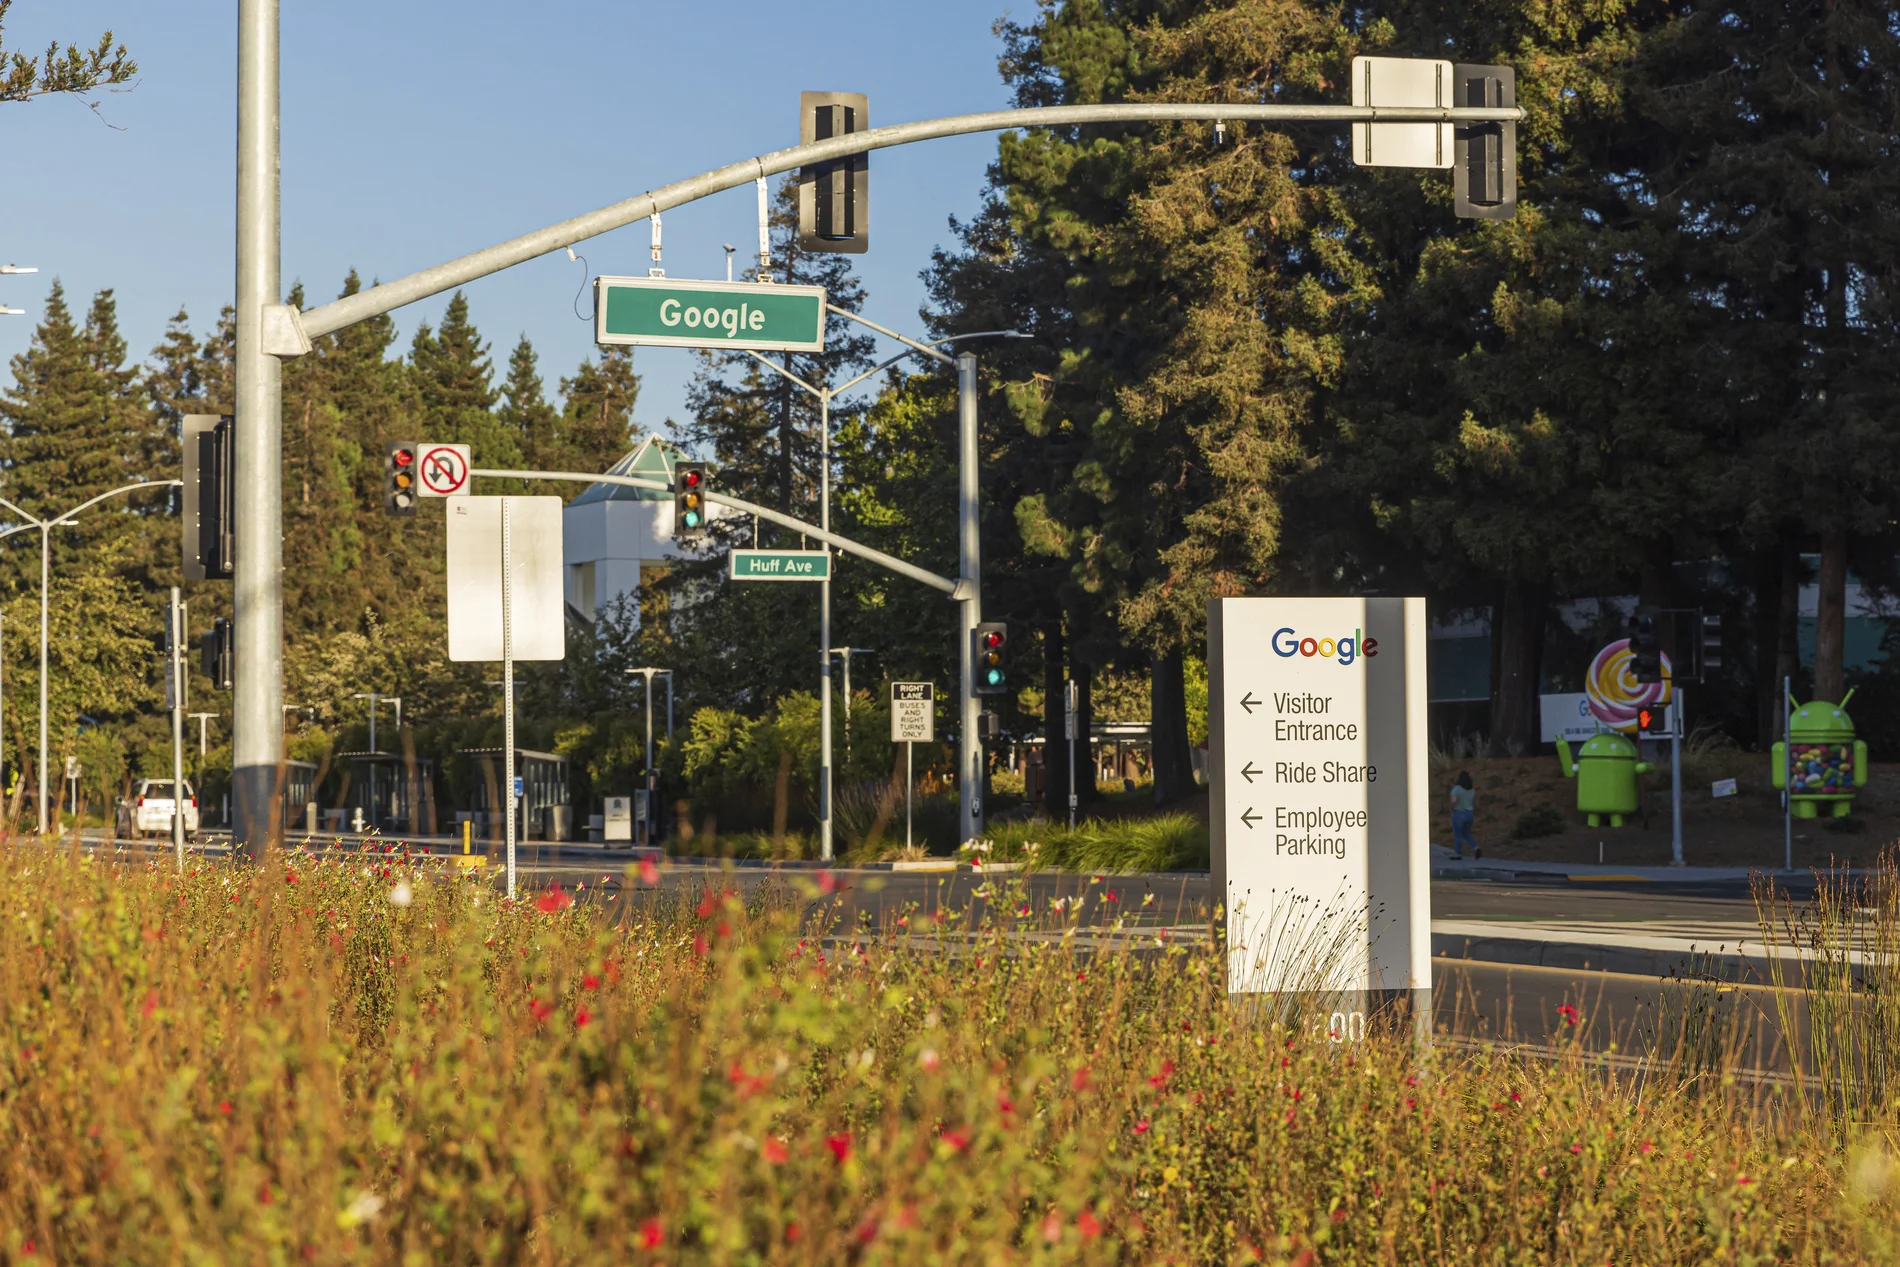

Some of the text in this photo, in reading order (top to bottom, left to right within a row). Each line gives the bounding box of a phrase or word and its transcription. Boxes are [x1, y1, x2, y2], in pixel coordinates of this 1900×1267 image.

[660, 299, 766, 338] Google
[750, 559, 812, 572] Huff Ave
[1271, 627, 1379, 665] Google
[1274, 692, 1332, 714] Visitor
[1275, 719, 1358, 741] Entrance
[1275, 761, 1377, 783] Ride Share
[1275, 806, 1367, 833] Employee
[1276, 834, 1346, 860] Parking
